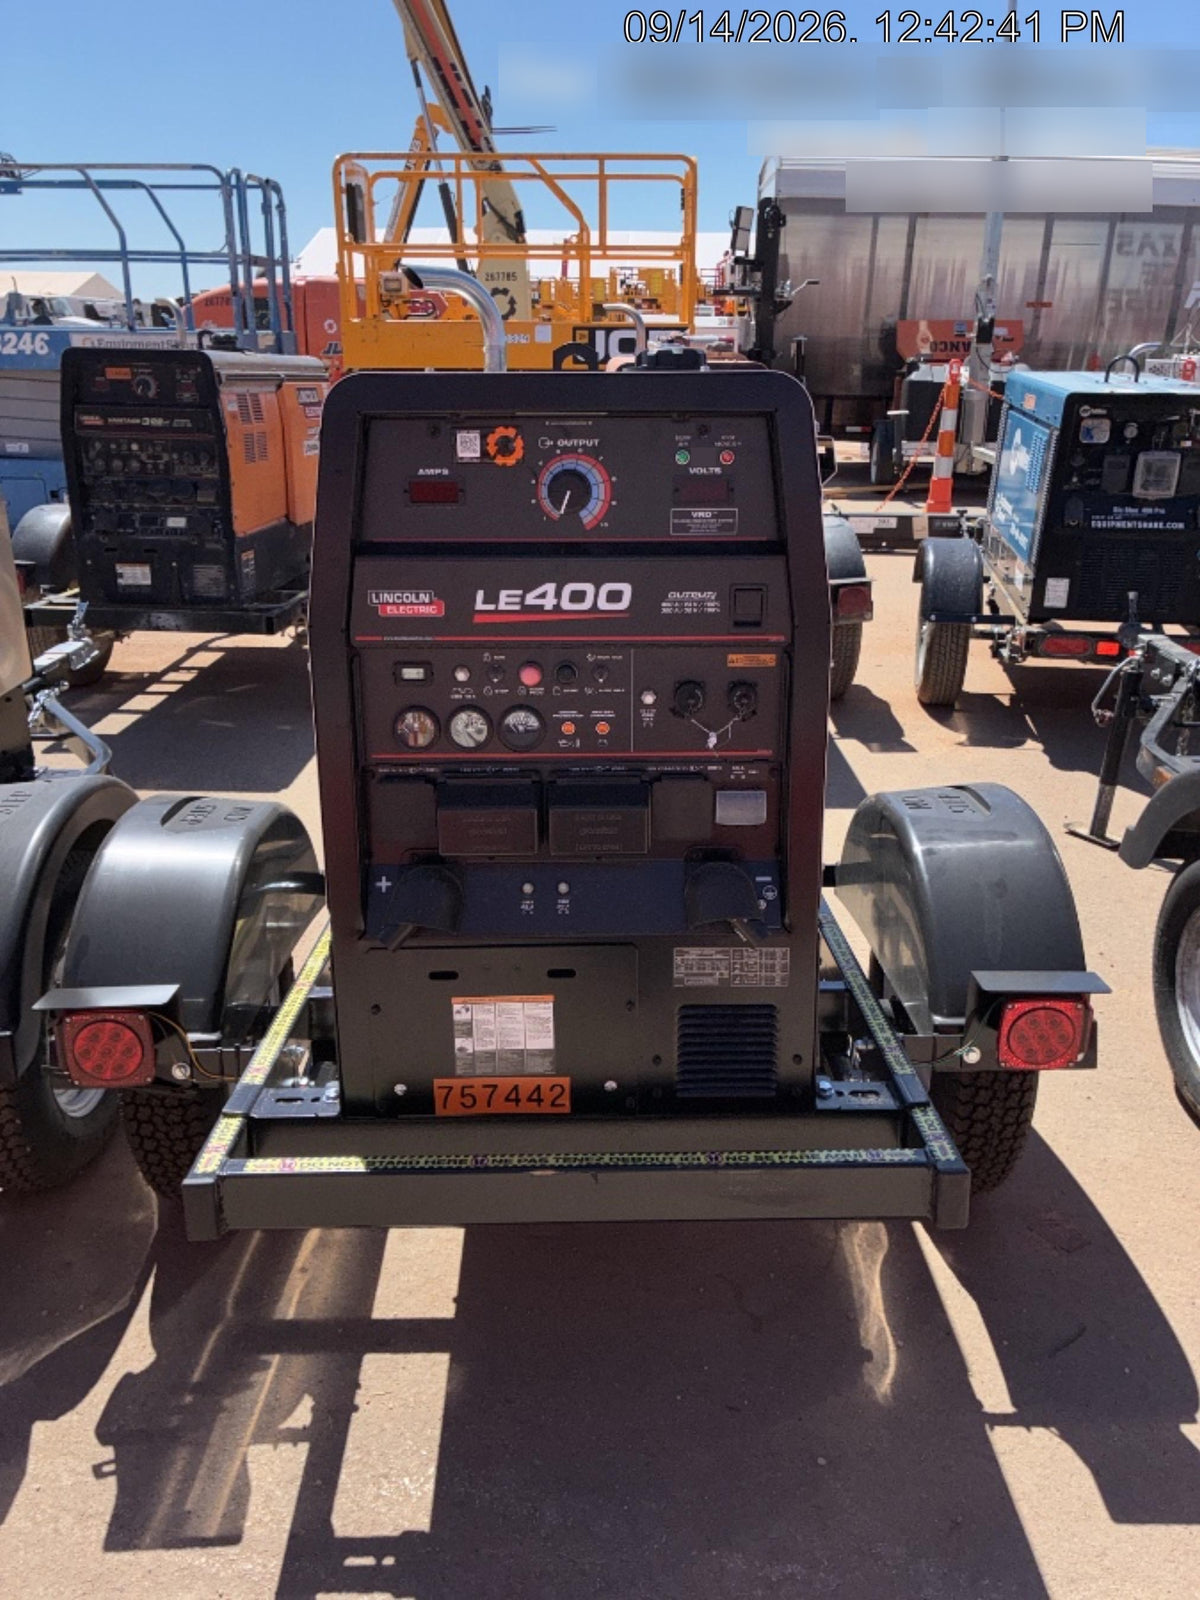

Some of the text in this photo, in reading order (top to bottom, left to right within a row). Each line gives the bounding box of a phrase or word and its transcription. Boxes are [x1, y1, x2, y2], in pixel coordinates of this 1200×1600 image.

[484, 271, 518, 281] 267785
[0, 331, 50, 355] 246
[557, 438, 600, 447] OUTPUT
[688, 466, 722, 475] VOLTS
[371, 592, 431, 604] LINCOLN
[474, 581, 633, 611] LE400
[386, 605, 438, 615] ELECTRIC
[437, 1083, 567, 1110] 757442
